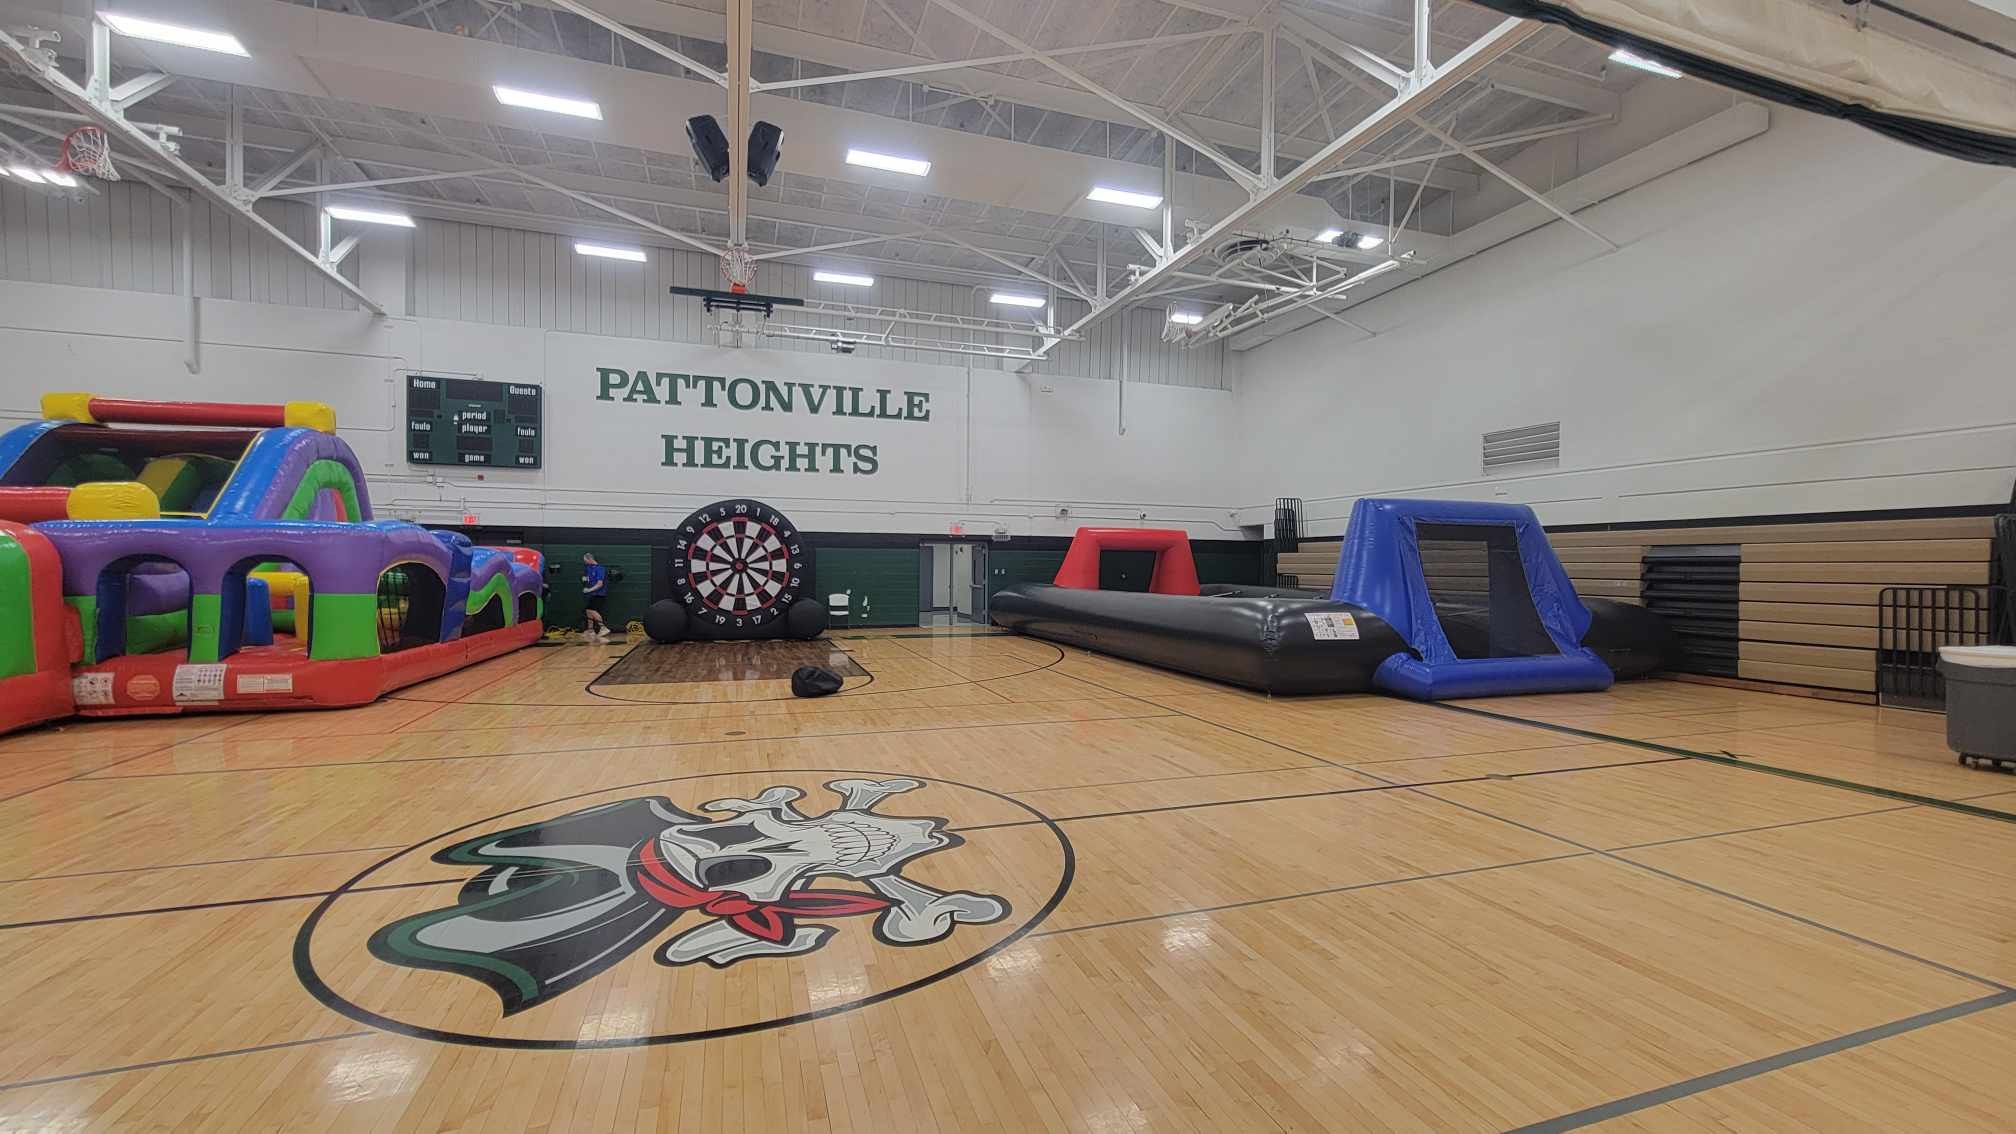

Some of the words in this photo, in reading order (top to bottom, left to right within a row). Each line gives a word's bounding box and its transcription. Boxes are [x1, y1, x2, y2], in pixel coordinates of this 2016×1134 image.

[413, 379, 436, 389] Home
[510, 386, 536, 396] Guests
[596, 367, 931, 422] PATTONVILLE
[462, 411, 487, 421] period
[411, 421, 431, 431] fouls
[462, 423, 488, 434] player
[517, 427, 535, 437] fouls
[413, 451, 429, 460] won
[464, 454, 484, 462] game
[661, 434, 879, 475] HEIGHTS
[519, 456, 534, 464] won
[720, 508, 726, 516] 5
[735, 505, 747, 513] 20
[699, 514, 711, 523] 12
[770, 515, 779, 526] 18
[676, 540, 687, 550] 14
[790, 544, 800, 554] 13
[674, 559, 684, 567] 11
[790, 577, 800, 586] 10
[684, 592, 694, 604] 16
[782, 594, 792, 603] 15
[715, 615, 726, 624] 19
[752, 615, 762, 624] 17
